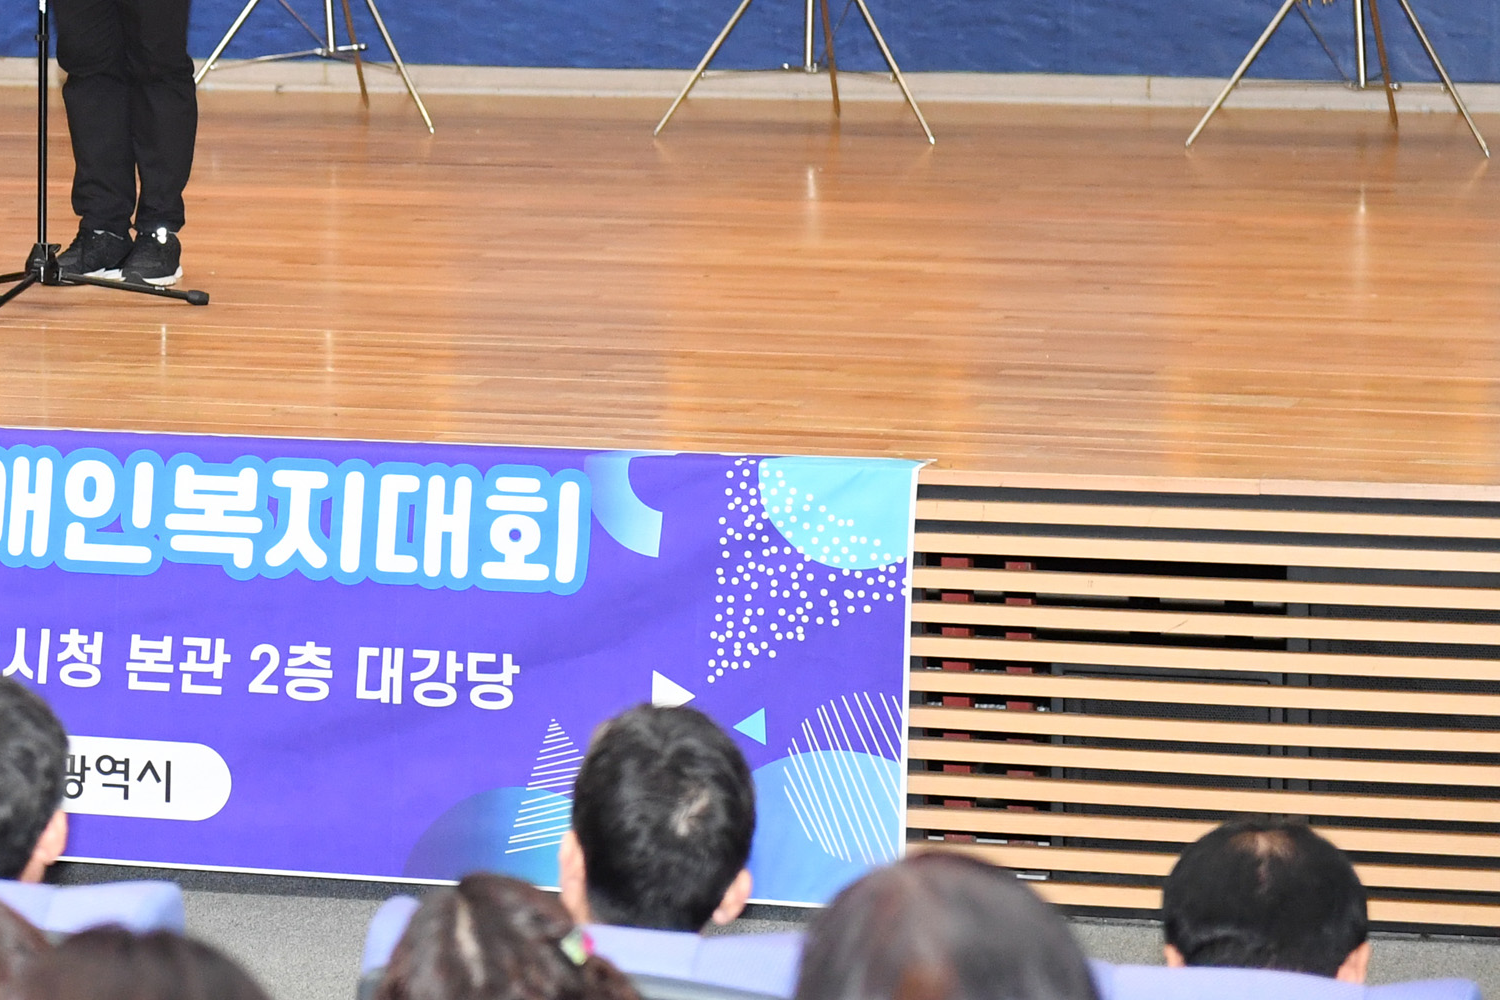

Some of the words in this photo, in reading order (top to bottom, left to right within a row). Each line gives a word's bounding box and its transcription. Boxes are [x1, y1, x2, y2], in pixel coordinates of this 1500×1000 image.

[125, 633, 231, 695] 본관
[248, 642, 333, 702] 2층
[355, 645, 520, 710] 대강당
